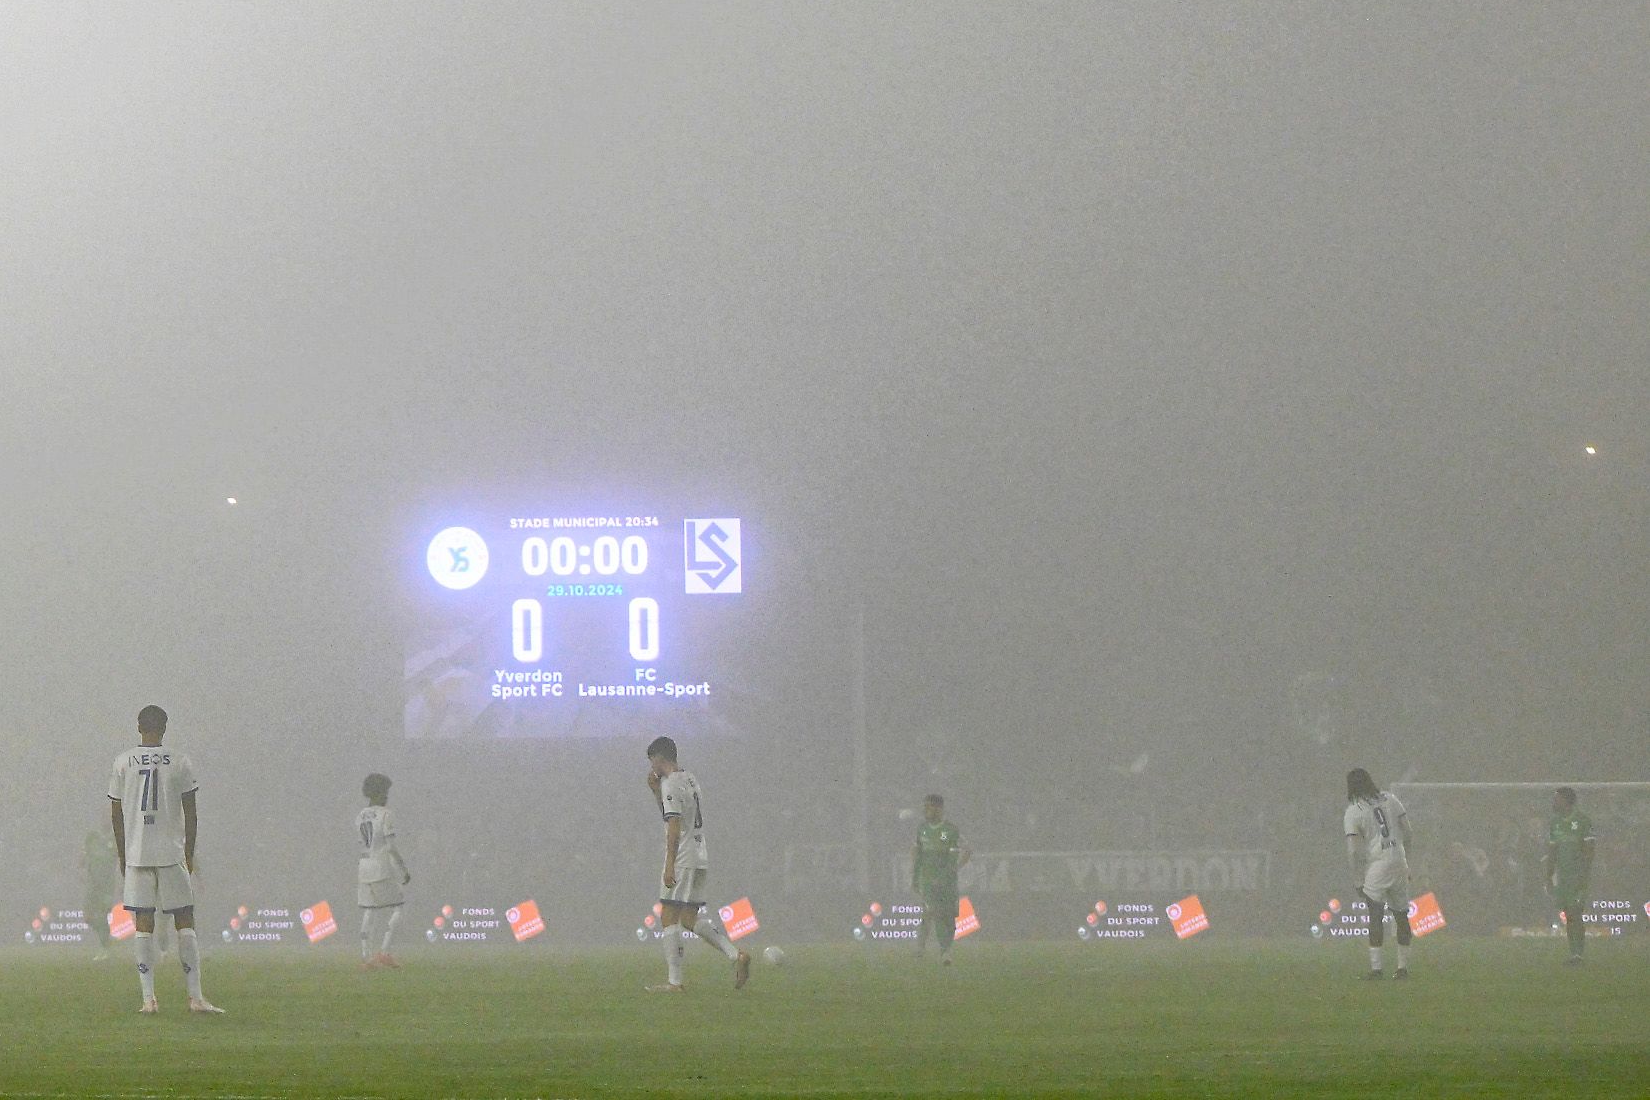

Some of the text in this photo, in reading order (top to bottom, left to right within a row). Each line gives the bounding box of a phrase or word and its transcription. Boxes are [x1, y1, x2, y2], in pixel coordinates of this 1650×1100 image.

[510, 516, 659, 528] STADE MUNICIPAL 20:34
[522, 536, 648, 576] 00:00
[547, 584, 623, 596] 29.10.2024
[512, 597, 659, 662] 0 0
[494, 669, 563, 683] Yverdon
[635, 669, 656, 681] FC
[491, 684, 563, 699] Sport FC
[578, 682, 711, 698] Lausanne-Sport
[128, 753, 171, 767] INEOS
[139, 767, 159, 811] 71
[1117, 904, 1154, 912] FONDS
[1592, 900, 1631, 909] FONDS
[257, 909, 289, 917] FONDS
[462, 908, 495, 916] FONDS
[882, 918, 896, 926] DU
[1107, 917, 1160, 925] DU SPORT
[1341, 915, 1357, 923] DU
[1582, 914, 1638, 922] DU SPORT
[249, 921, 294, 929] DU SPORT
[453, 920, 500, 928] DU SPORT
[443, 932, 487, 940] VAUDOIS
[872, 930, 918, 938] VAUDOIS
[1097, 930, 1145, 938] VAUDOIS
[1330, 928, 1370, 936] VAUDO
[40, 934, 82, 942] VAUDOIS
[238, 933, 282, 941] VAUDOIS
